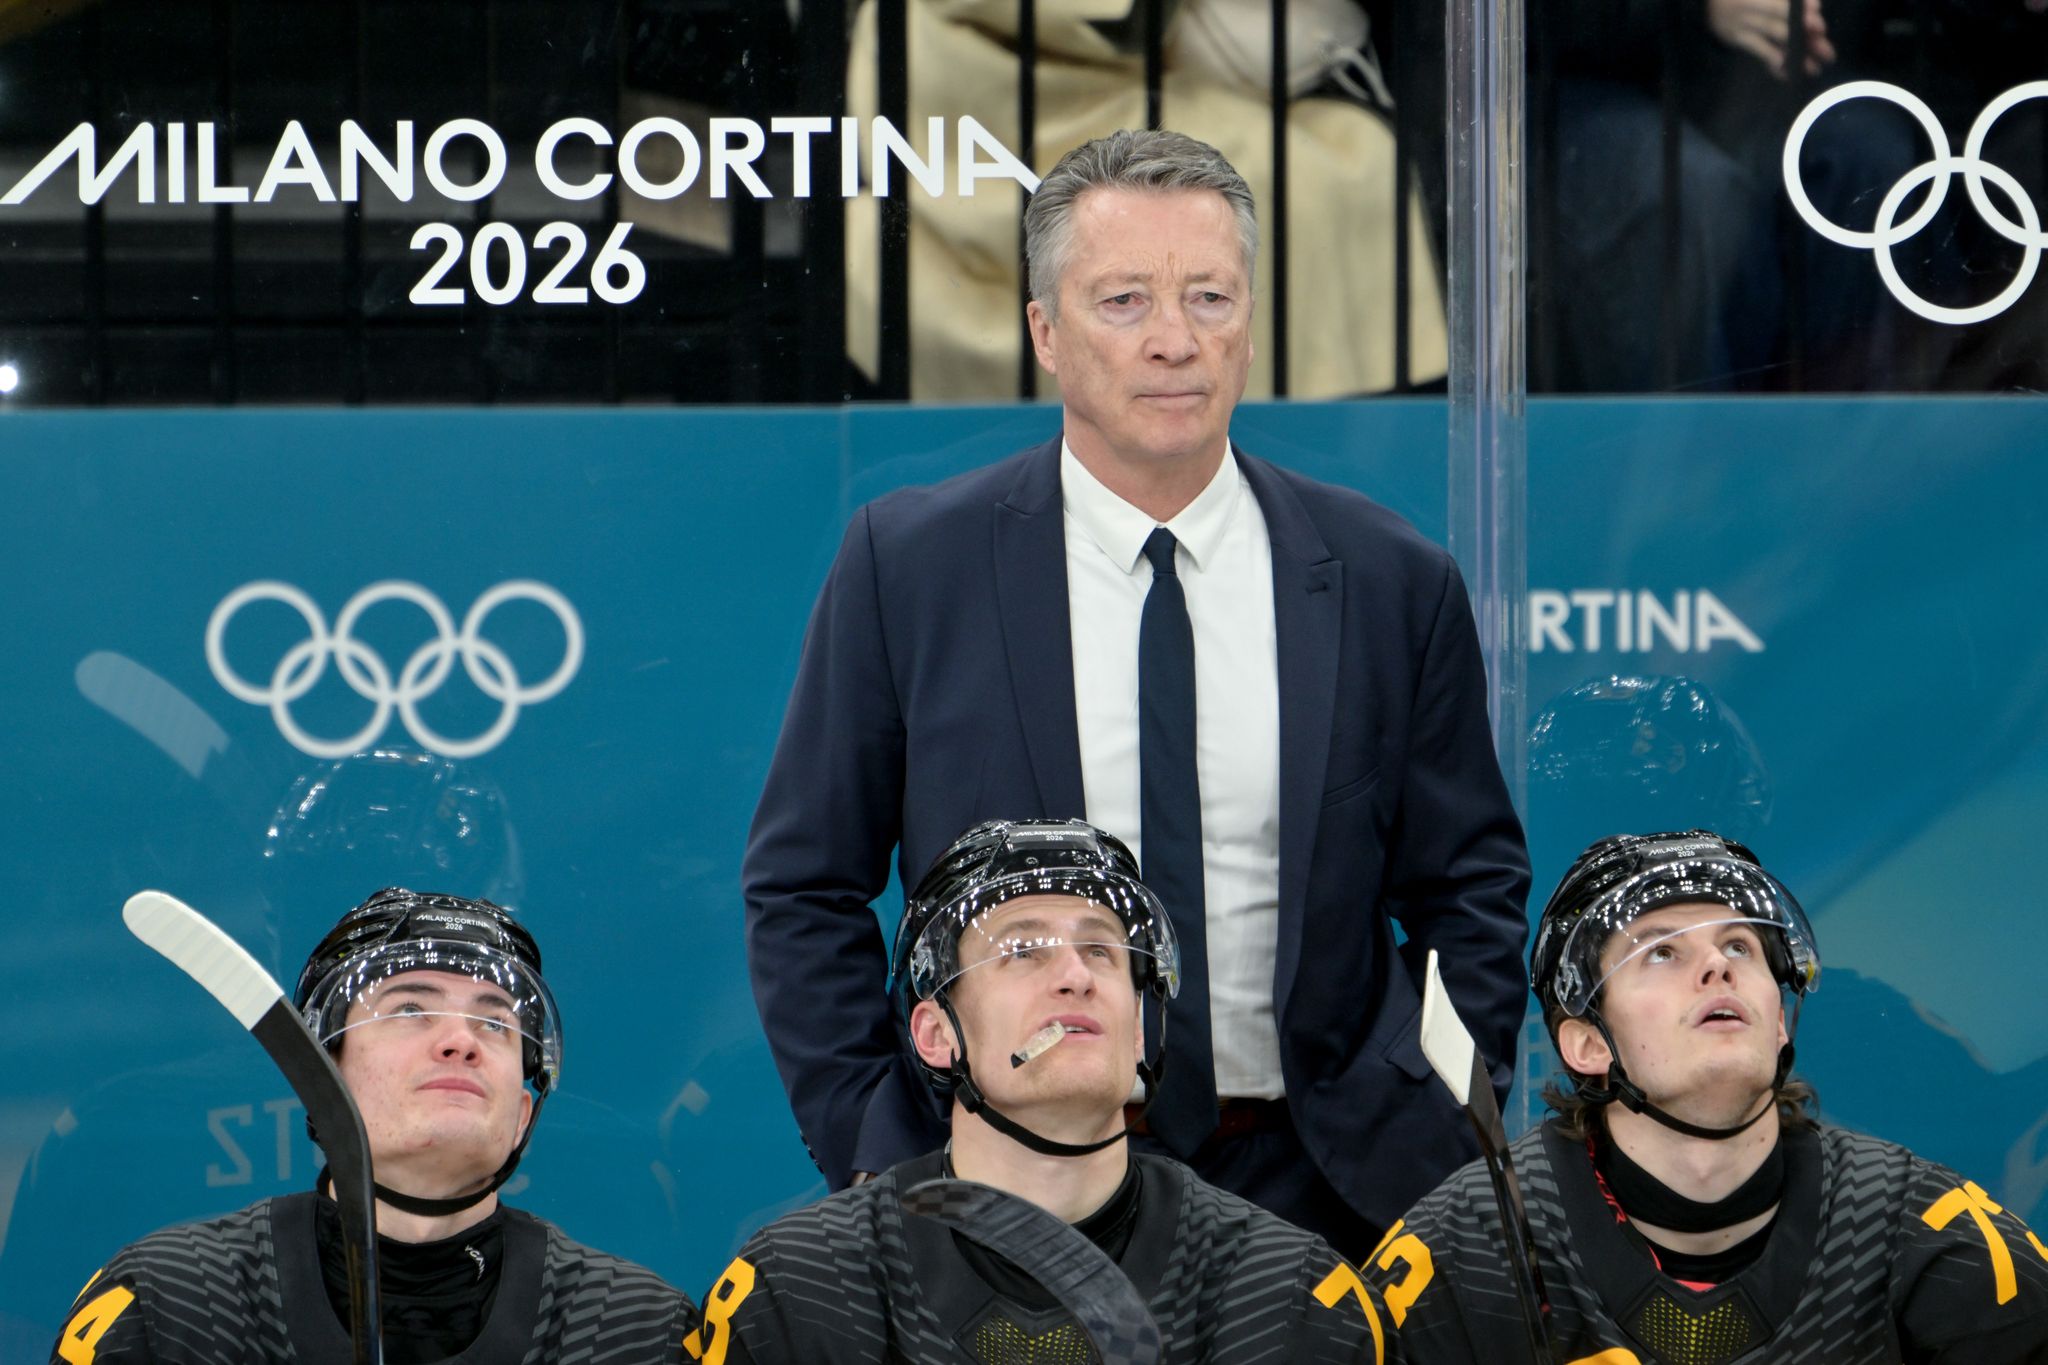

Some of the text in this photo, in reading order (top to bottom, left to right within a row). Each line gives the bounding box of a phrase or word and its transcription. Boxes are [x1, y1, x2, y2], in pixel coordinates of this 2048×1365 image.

[0, 115, 1041, 205] MILANO CORTINA
[409, 222, 646, 305] 2026
[1528, 588, 1765, 653] RTINA
[1648, 846, 1683, 857] MILANO
[1677, 850, 1695, 858] 2026
[416, 914, 491, 929] MILANO CORTINA
[445, 922, 463, 931] 2026
[58, 1268, 135, 1365] 4
